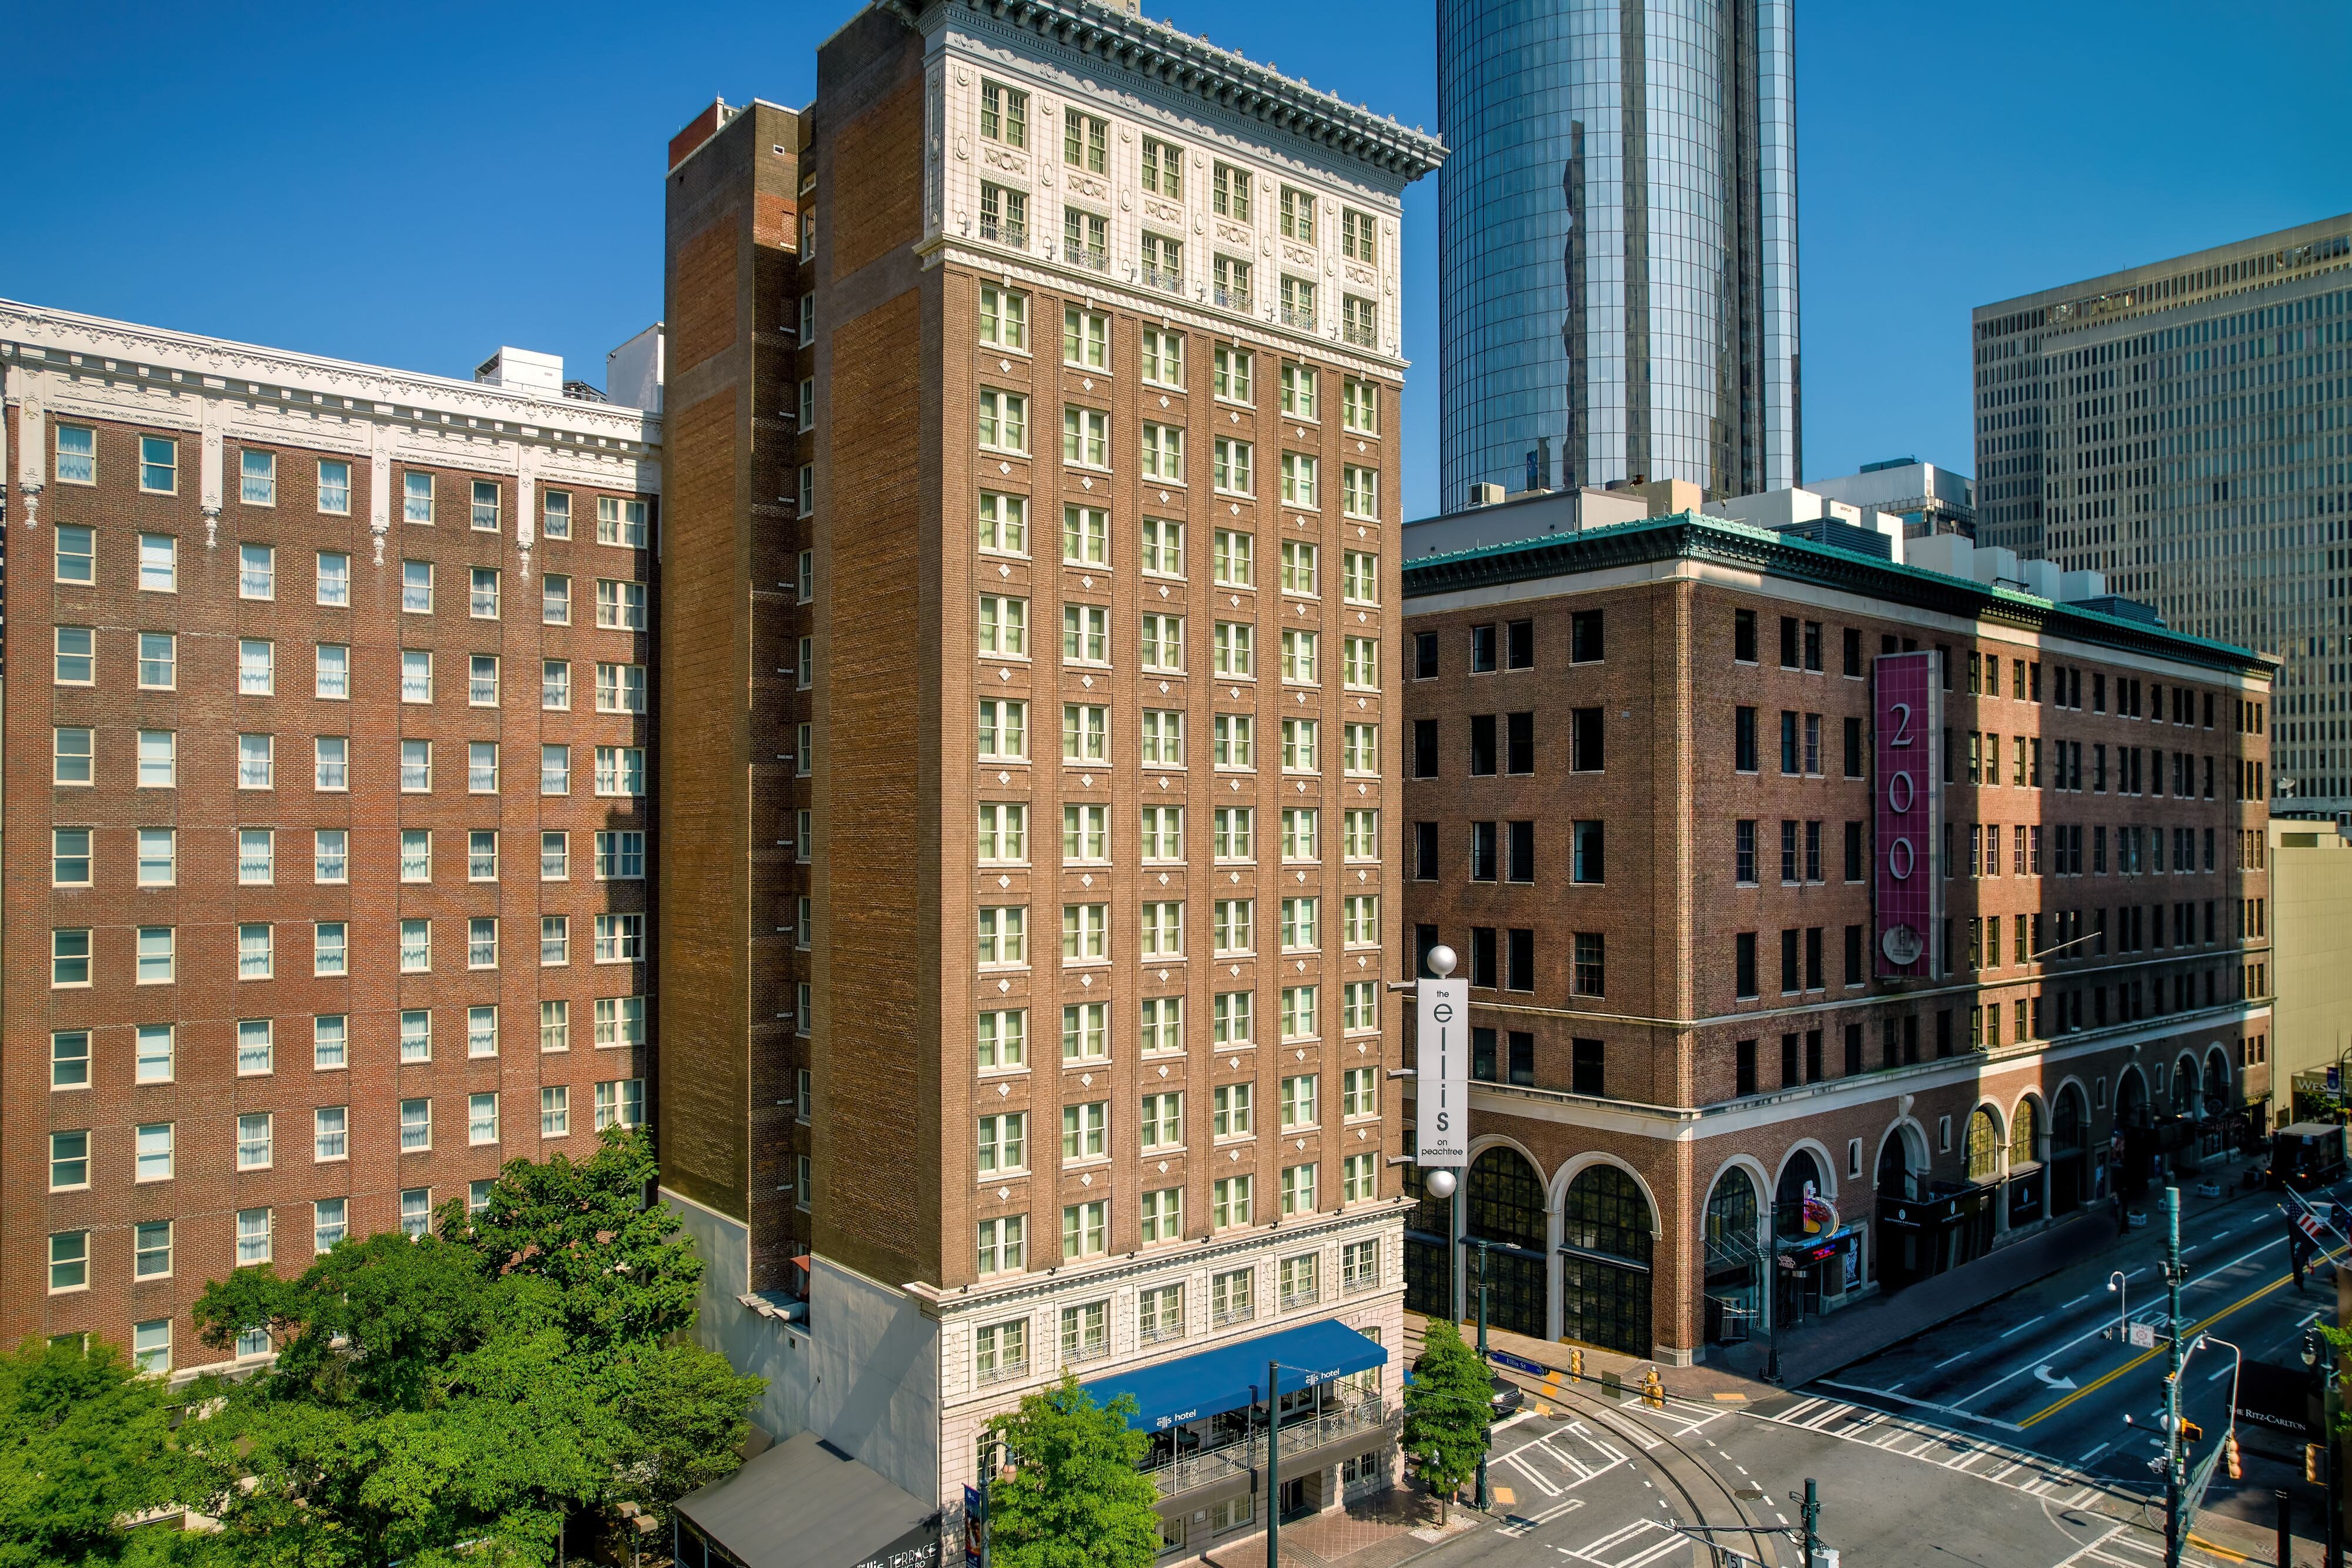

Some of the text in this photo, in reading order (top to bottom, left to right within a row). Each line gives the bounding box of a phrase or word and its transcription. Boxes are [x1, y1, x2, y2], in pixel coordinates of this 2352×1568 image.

[1889, 703, 1915, 880] 200
[1434, 1003, 1453, 1132] ellis
[2296, 1077, 2348, 1094] WESIN
[1421, 1147, 1463, 1156] peachtree
[1506, 1358, 1519, 1367] Ellis
[1305, 1368, 1339, 1385] ellis hotel
[1157, 1409, 1196, 1429] ellis hotel
[2246, 1409, 2306, 1430] RITZ-CARLTON
[888, 1543, 936, 1568] TERRACE
